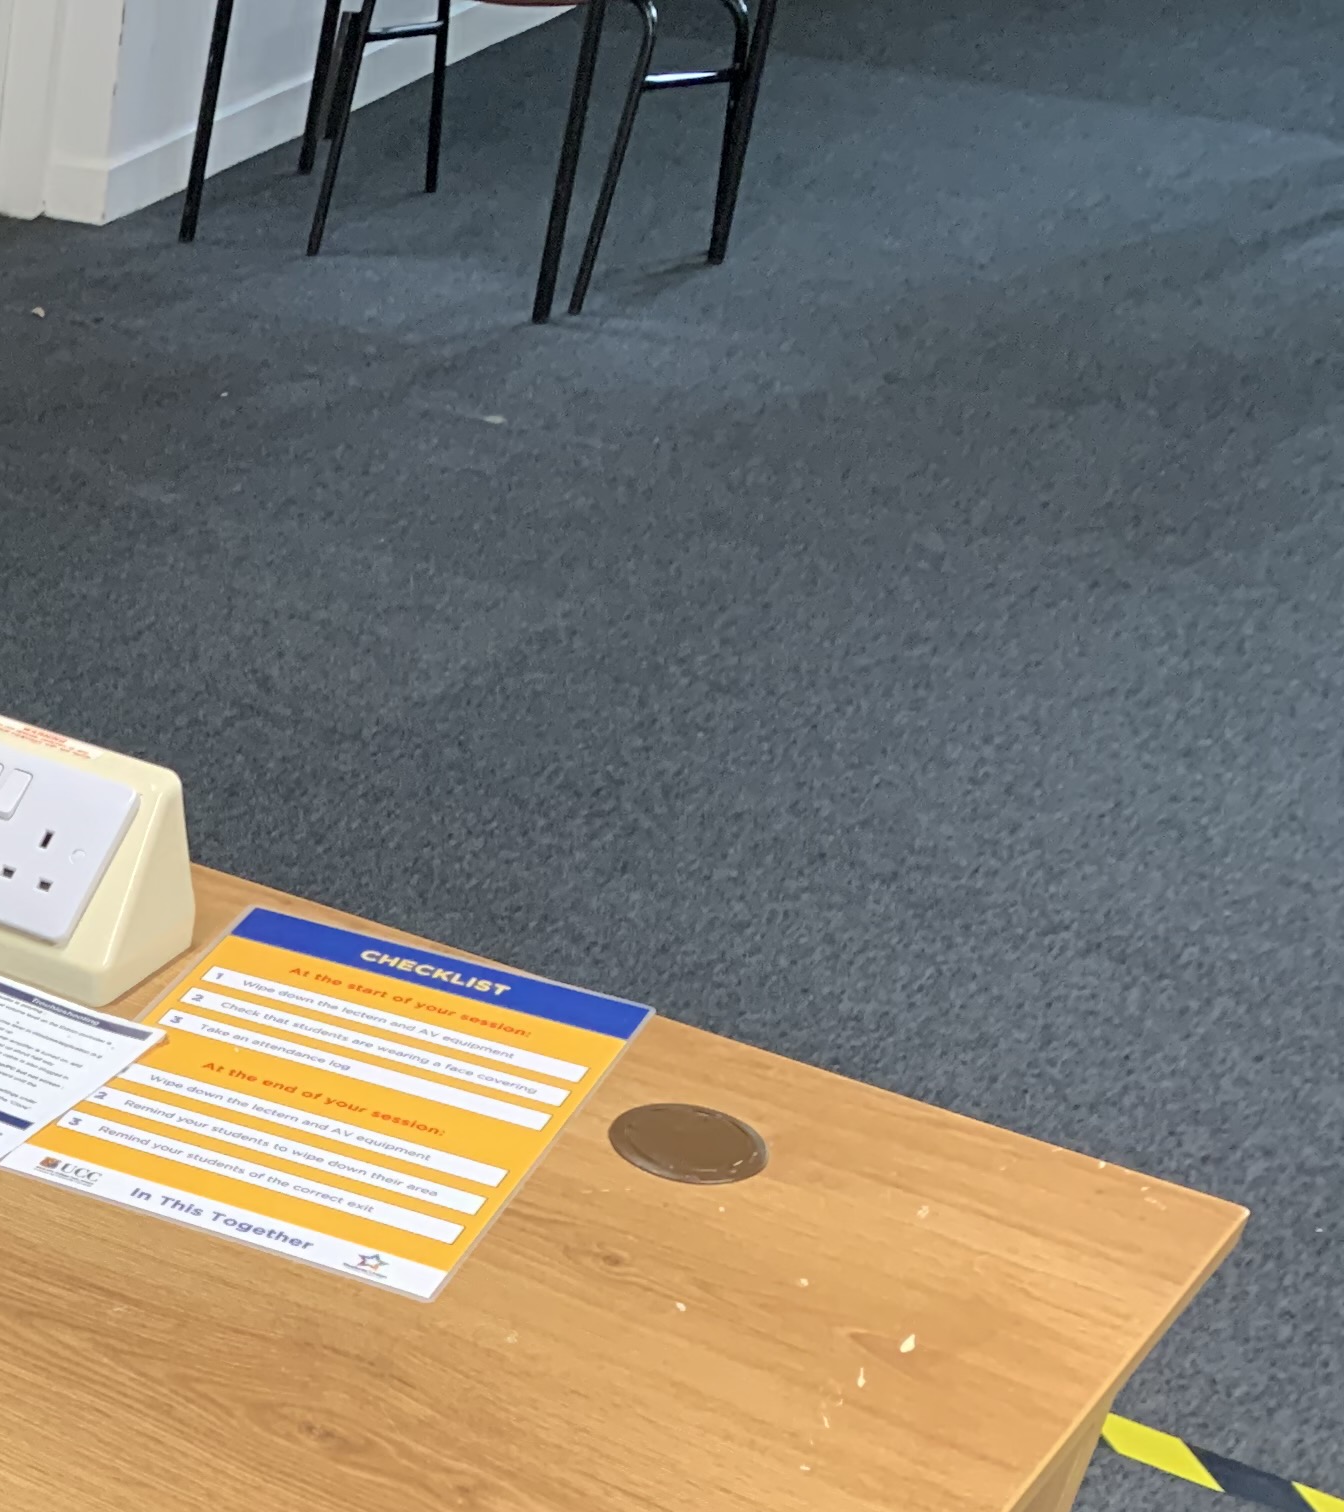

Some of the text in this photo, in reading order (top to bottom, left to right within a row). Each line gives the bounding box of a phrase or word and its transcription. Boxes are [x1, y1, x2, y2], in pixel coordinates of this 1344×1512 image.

[288, 966, 533, 1038] At the start of your session:
[355, 948, 513, 997] CHECKLIST
[29, 997, 102, 1025] Troubleshooting
[168, 1015, 352, 1072] 3 Take an attendance log
[190, 993, 205, 1002] 2
[218, 1001, 262, 1017] Check
[261, 1013, 292, 1025] that
[290, 1021, 351, 1042] students
[349, 1038, 375, 1049] are
[374, 1045, 431, 1065] wearing
[442, 1063, 475, 1077] face
[474, 1072, 539, 1095] covering
[239, 979, 277, 994] Wipe
[276, 989, 316, 1004] down
[315, 1000, 340, 1011] the
[339, 1006, 389, 1024] lectern
[387, 1019, 417, 1032] and
[416, 1028, 440, 1038] AV
[439, 1034, 516, 1060] equipment
[146, 1073, 432, 1163] Wipe down the lectern and AV equipment
[201, 1061, 447, 1137] At the end of your session:
[61, 1163, 103, 1182] UCC
[66, 1117, 376, 1214] 3 Remind your students of the correct exit
[93, 1090, 440, 1198] 2 Remind your students to wipe down their area
[128, 1186, 317, 1253] In This Together
